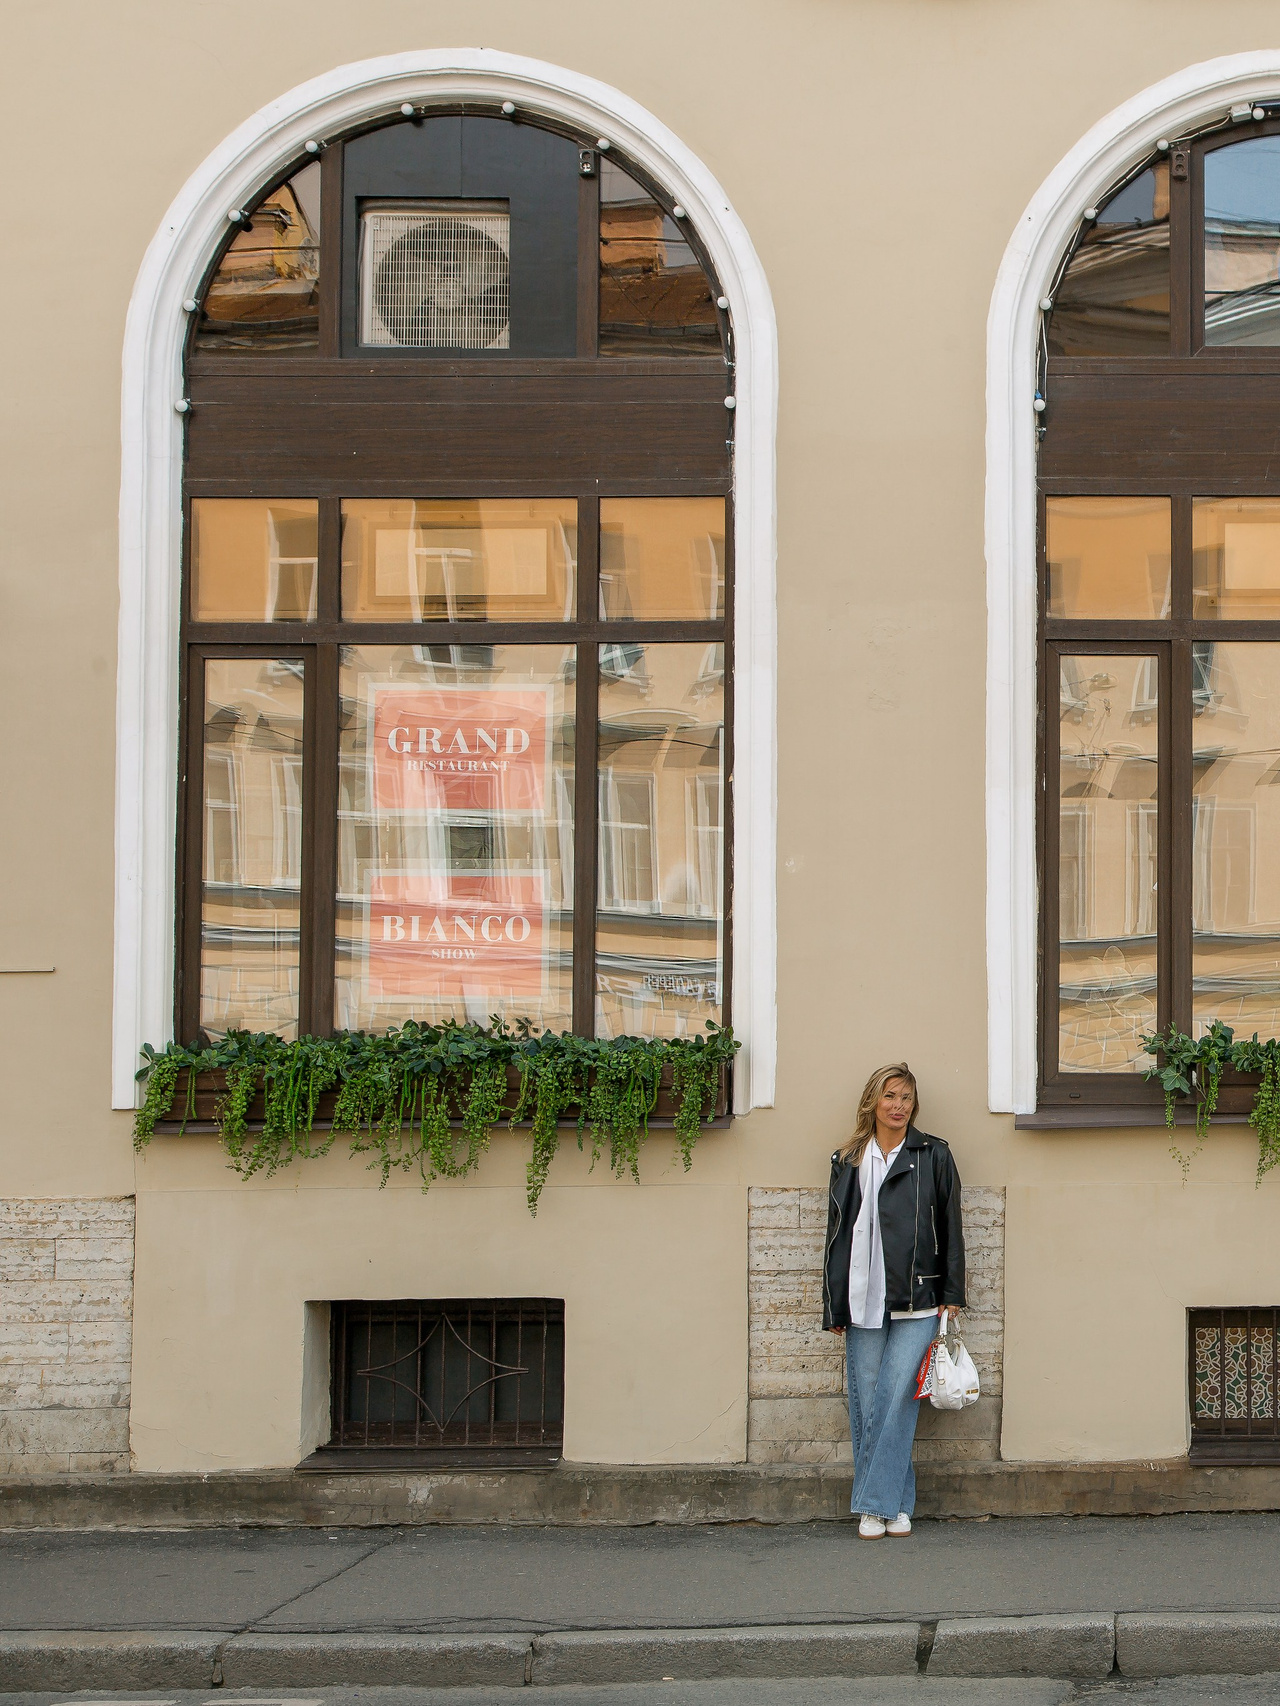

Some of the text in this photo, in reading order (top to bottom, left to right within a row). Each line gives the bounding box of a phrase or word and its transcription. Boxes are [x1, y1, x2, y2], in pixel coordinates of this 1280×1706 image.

[388, 727, 530, 754] GRAND
[407, 760, 510, 771] RESTAURANT
[381, 915, 531, 942] BIANCO
[431, 948, 477, 960] SHOW
